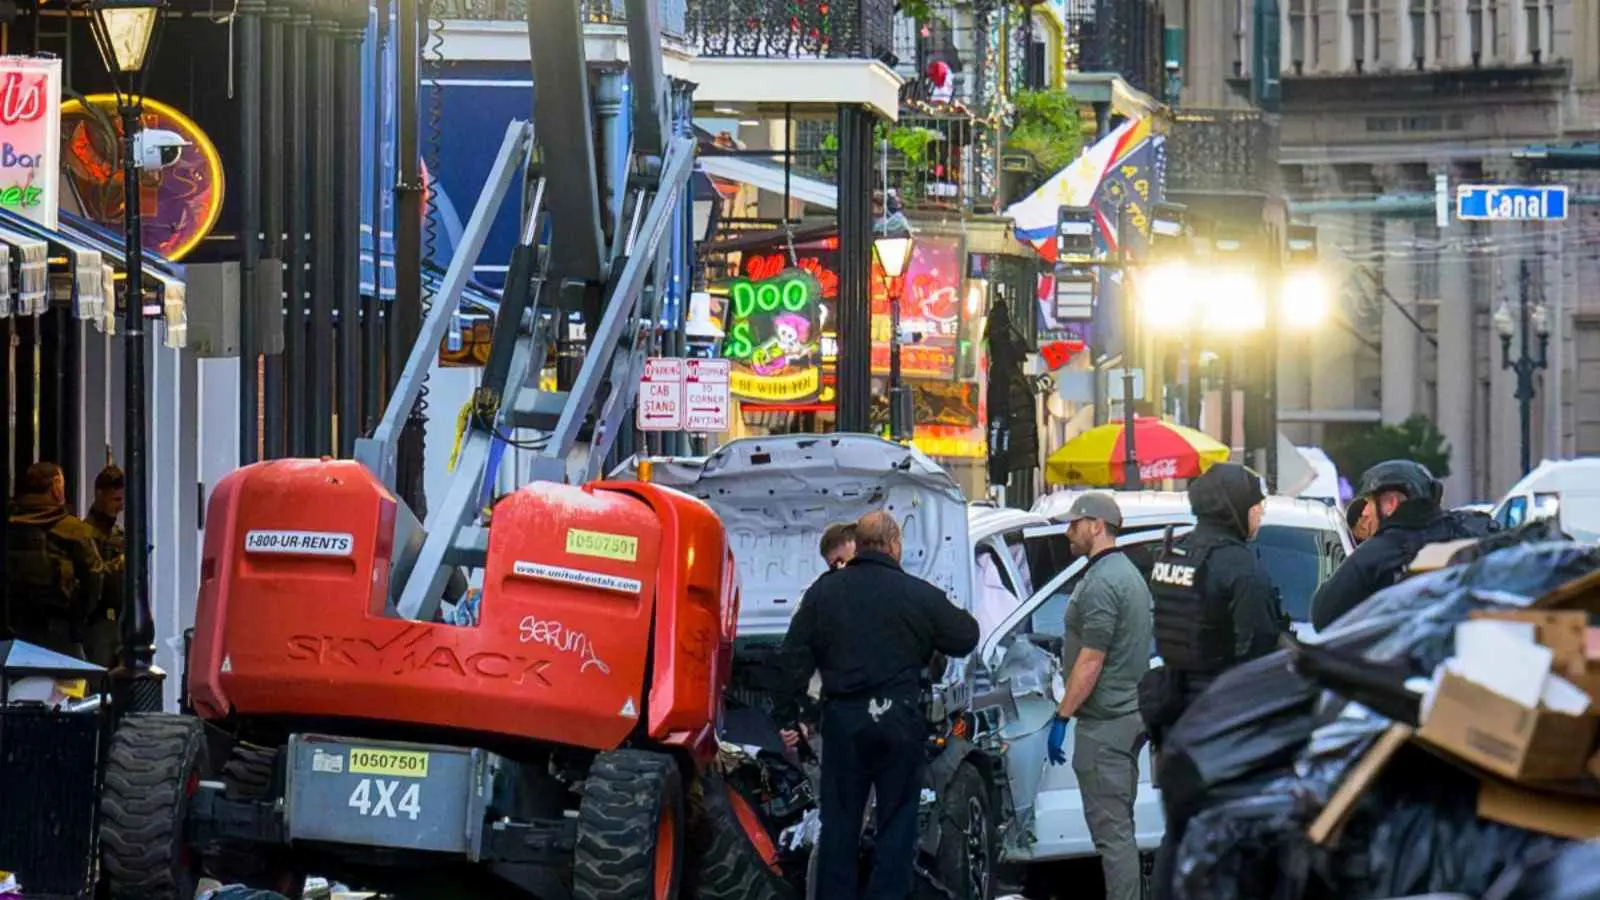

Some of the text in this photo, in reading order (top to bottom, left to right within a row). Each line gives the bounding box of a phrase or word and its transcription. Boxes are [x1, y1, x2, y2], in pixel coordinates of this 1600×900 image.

[2, 143, 42, 168] Bar
[1486, 187, 1547, 218] Canal
[650, 385, 670, 396] CAB
[644, 400, 676, 412] STAND
[247, 533, 350, 551] 1-800-UR-RENTS
[287, 623, 552, 688] SKYJACK
[351, 752, 427, 771] 10507501
[347, 778, 421, 820] 4X4
